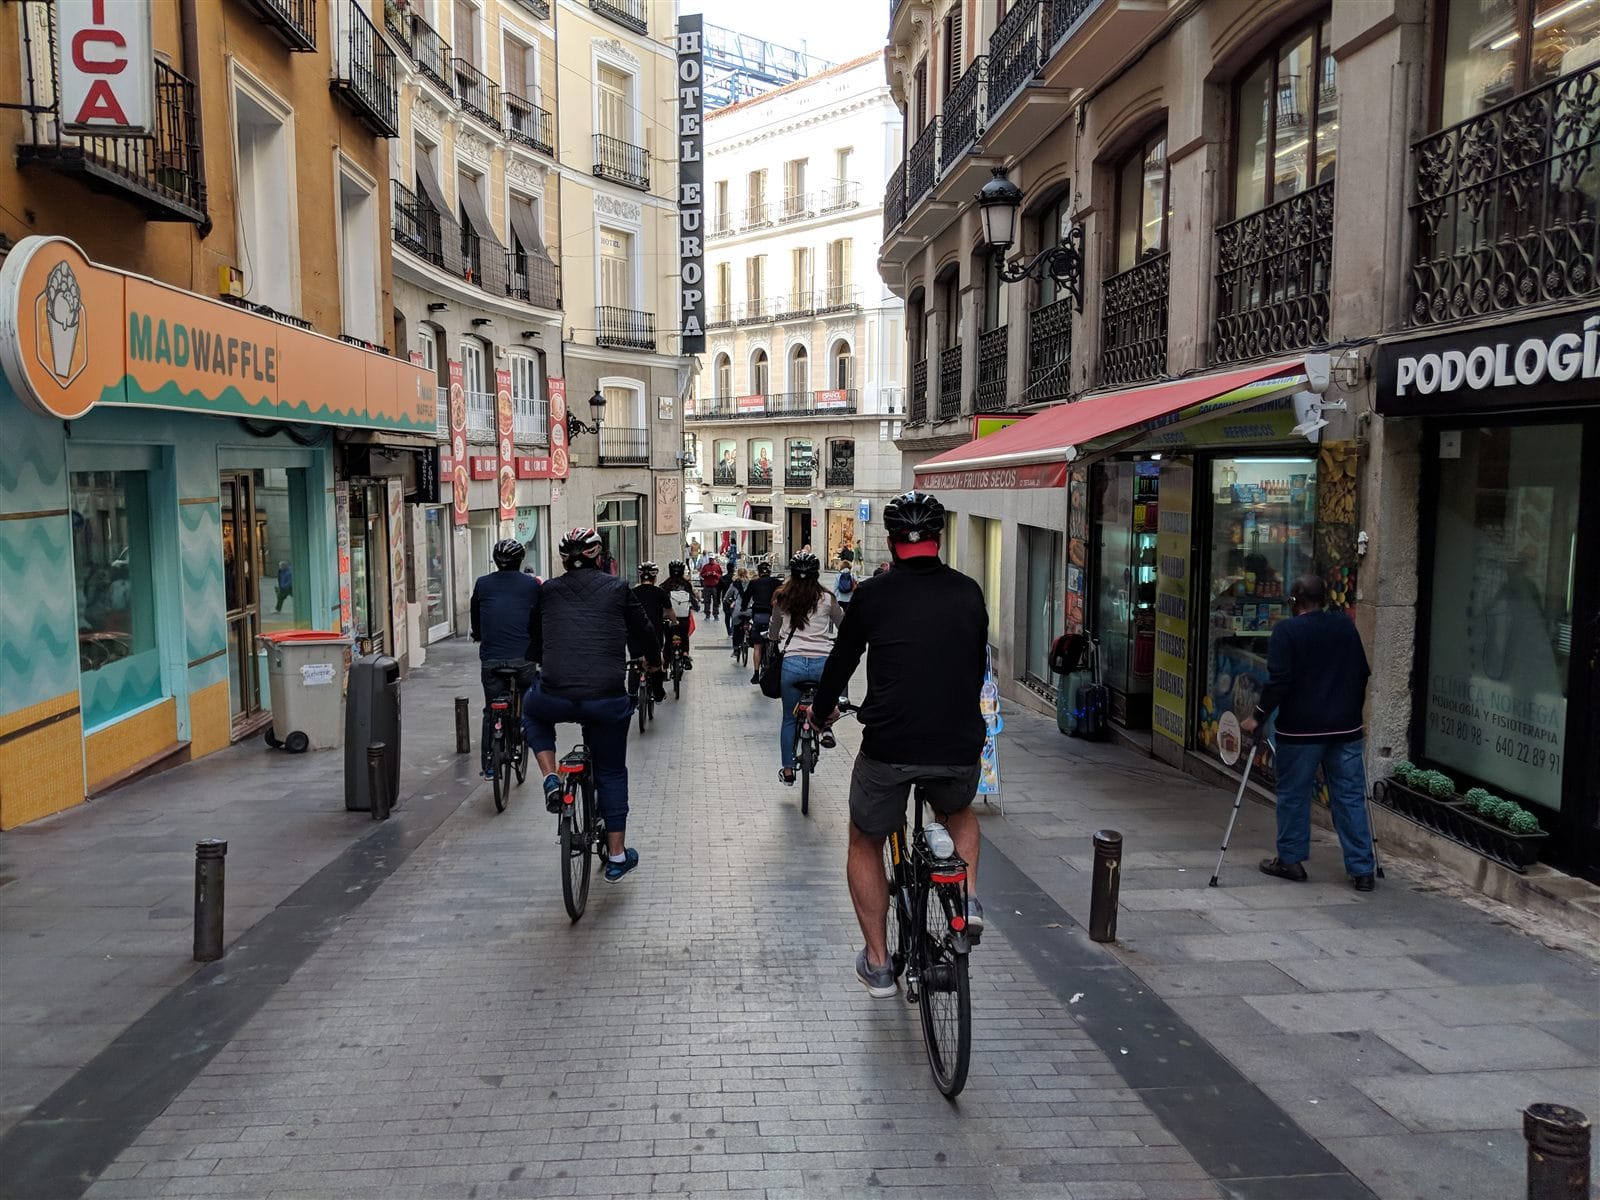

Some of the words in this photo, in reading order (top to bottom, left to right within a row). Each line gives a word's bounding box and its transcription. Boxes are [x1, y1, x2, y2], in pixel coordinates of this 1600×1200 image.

[678, 31, 701, 163] HOTEL
[600, 237, 621, 249] HOTEL
[680, 183, 704, 337] EUROPA
[129, 311, 276, 384] MADWAFFLE
[1396, 315, 1600, 396] PODOLOGÍ
[711, 495, 737, 504] SEPHORA
[964, 472, 989, 488] FRUTOS
[990, 470, 1017, 487] SECOS
[1441, 715, 1455, 736] 521
[1456, 719, 1468, 741] 80
[1471, 727, 1482, 746] 98
[1495, 735, 1514, 758] 640
[1517, 742, 1529, 764] 22
[1532, 746, 1546, 767] 89
[1549, 752, 1560, 776] 91
[1483, 711, 1490, 721] Y
[1492, 713, 1559, 745] FISIOTERAPIA
